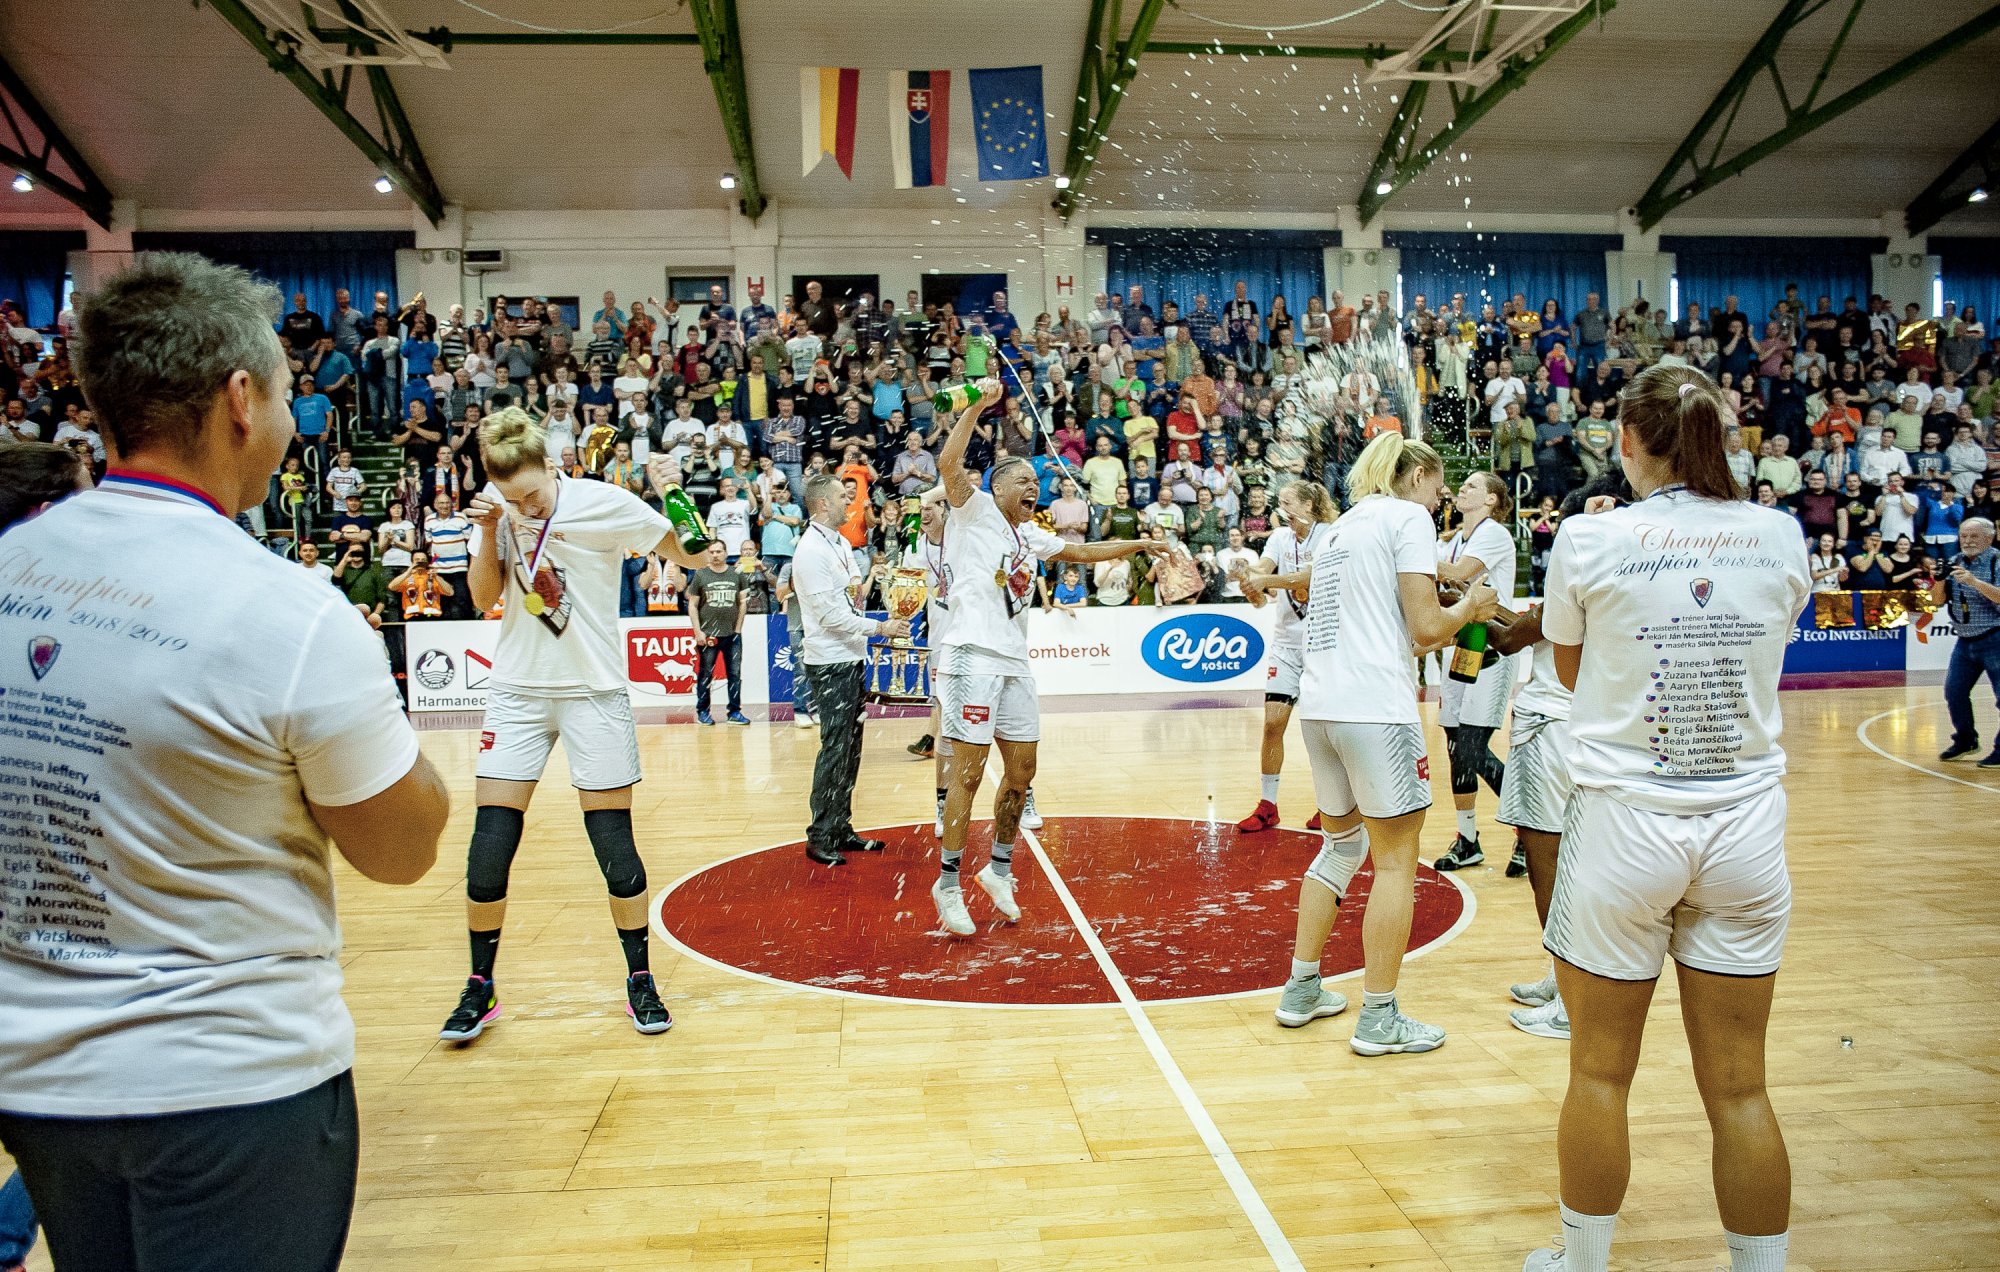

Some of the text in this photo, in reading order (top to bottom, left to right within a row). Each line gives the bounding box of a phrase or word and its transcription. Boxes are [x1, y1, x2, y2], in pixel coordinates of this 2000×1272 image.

[1633, 523, 1762, 558] Champion
[1614, 552, 1785, 581] šampión 2018/2019
[1706, 613, 1723, 621] Juraj
[1724, 613, 1740, 621] Suja
[68, 609, 189, 651] 2018/2019
[1646, 633, 1668, 641] lekári
[1668, 632, 1682, 640] Ján
[1720, 630, 1745, 638] Michal
[1158, 626, 1249, 670] Ryba
[1665, 641, 1696, 649] masérka
[1028, 643, 1111, 659] omberok
[1201, 660, 1241, 673] KOŠICE
[1673, 657, 1743, 669] Janeesa Jeffery
[1663, 671, 1698, 680] Zuzana
[1669, 680, 1743, 692] Aaryn Ellenberg
[417, 696, 487, 707] Harmanec
[1659, 693, 1708, 702] Alexandra
[1673, 701, 1738, 712] Radka Stašová
[1658, 715, 1704, 724] Miroslava
[1663, 735, 1690, 745] Beáta
[1662, 746, 1685, 757] Alica
[47, 761, 89, 786] Jeffery
[33, 794, 91, 821] Ellenberg
